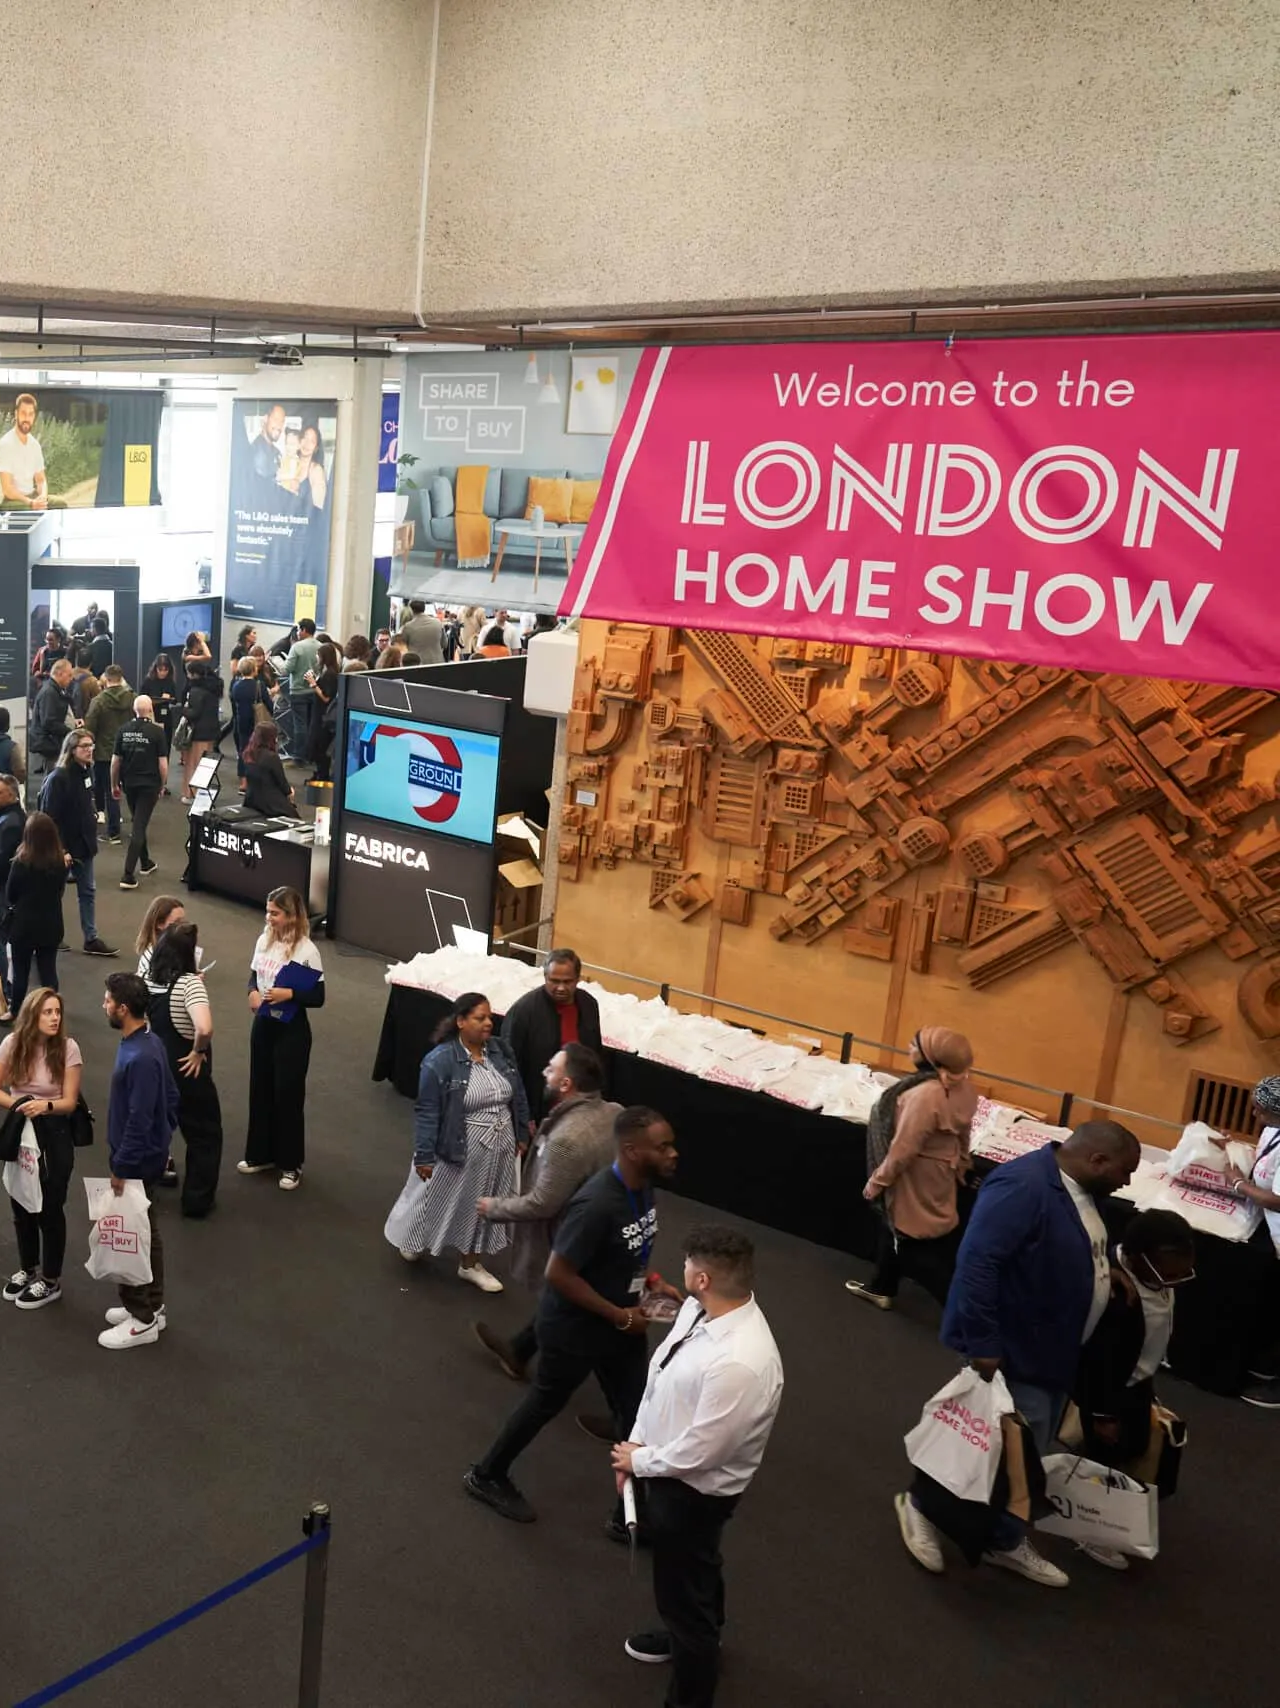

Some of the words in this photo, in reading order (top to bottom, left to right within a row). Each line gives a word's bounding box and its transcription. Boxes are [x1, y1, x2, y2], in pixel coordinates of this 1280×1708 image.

[429, 383, 488, 400] SHARE
[772, 365, 977, 408] Welcome
[991, 370, 1038, 408] to
[1056, 359, 1136, 409] the
[435, 416, 458, 432] TO
[477, 422, 513, 438] BUY
[680, 439, 1240, 551] LONDON
[674, 548, 897, 620] HOME
[917, 564, 1214, 646] SHOW
[345, 831, 430, 872] FABRICA
[115, 1237, 132, 1246] BUY
[1077, 1503, 1100, 1516] Hyde
